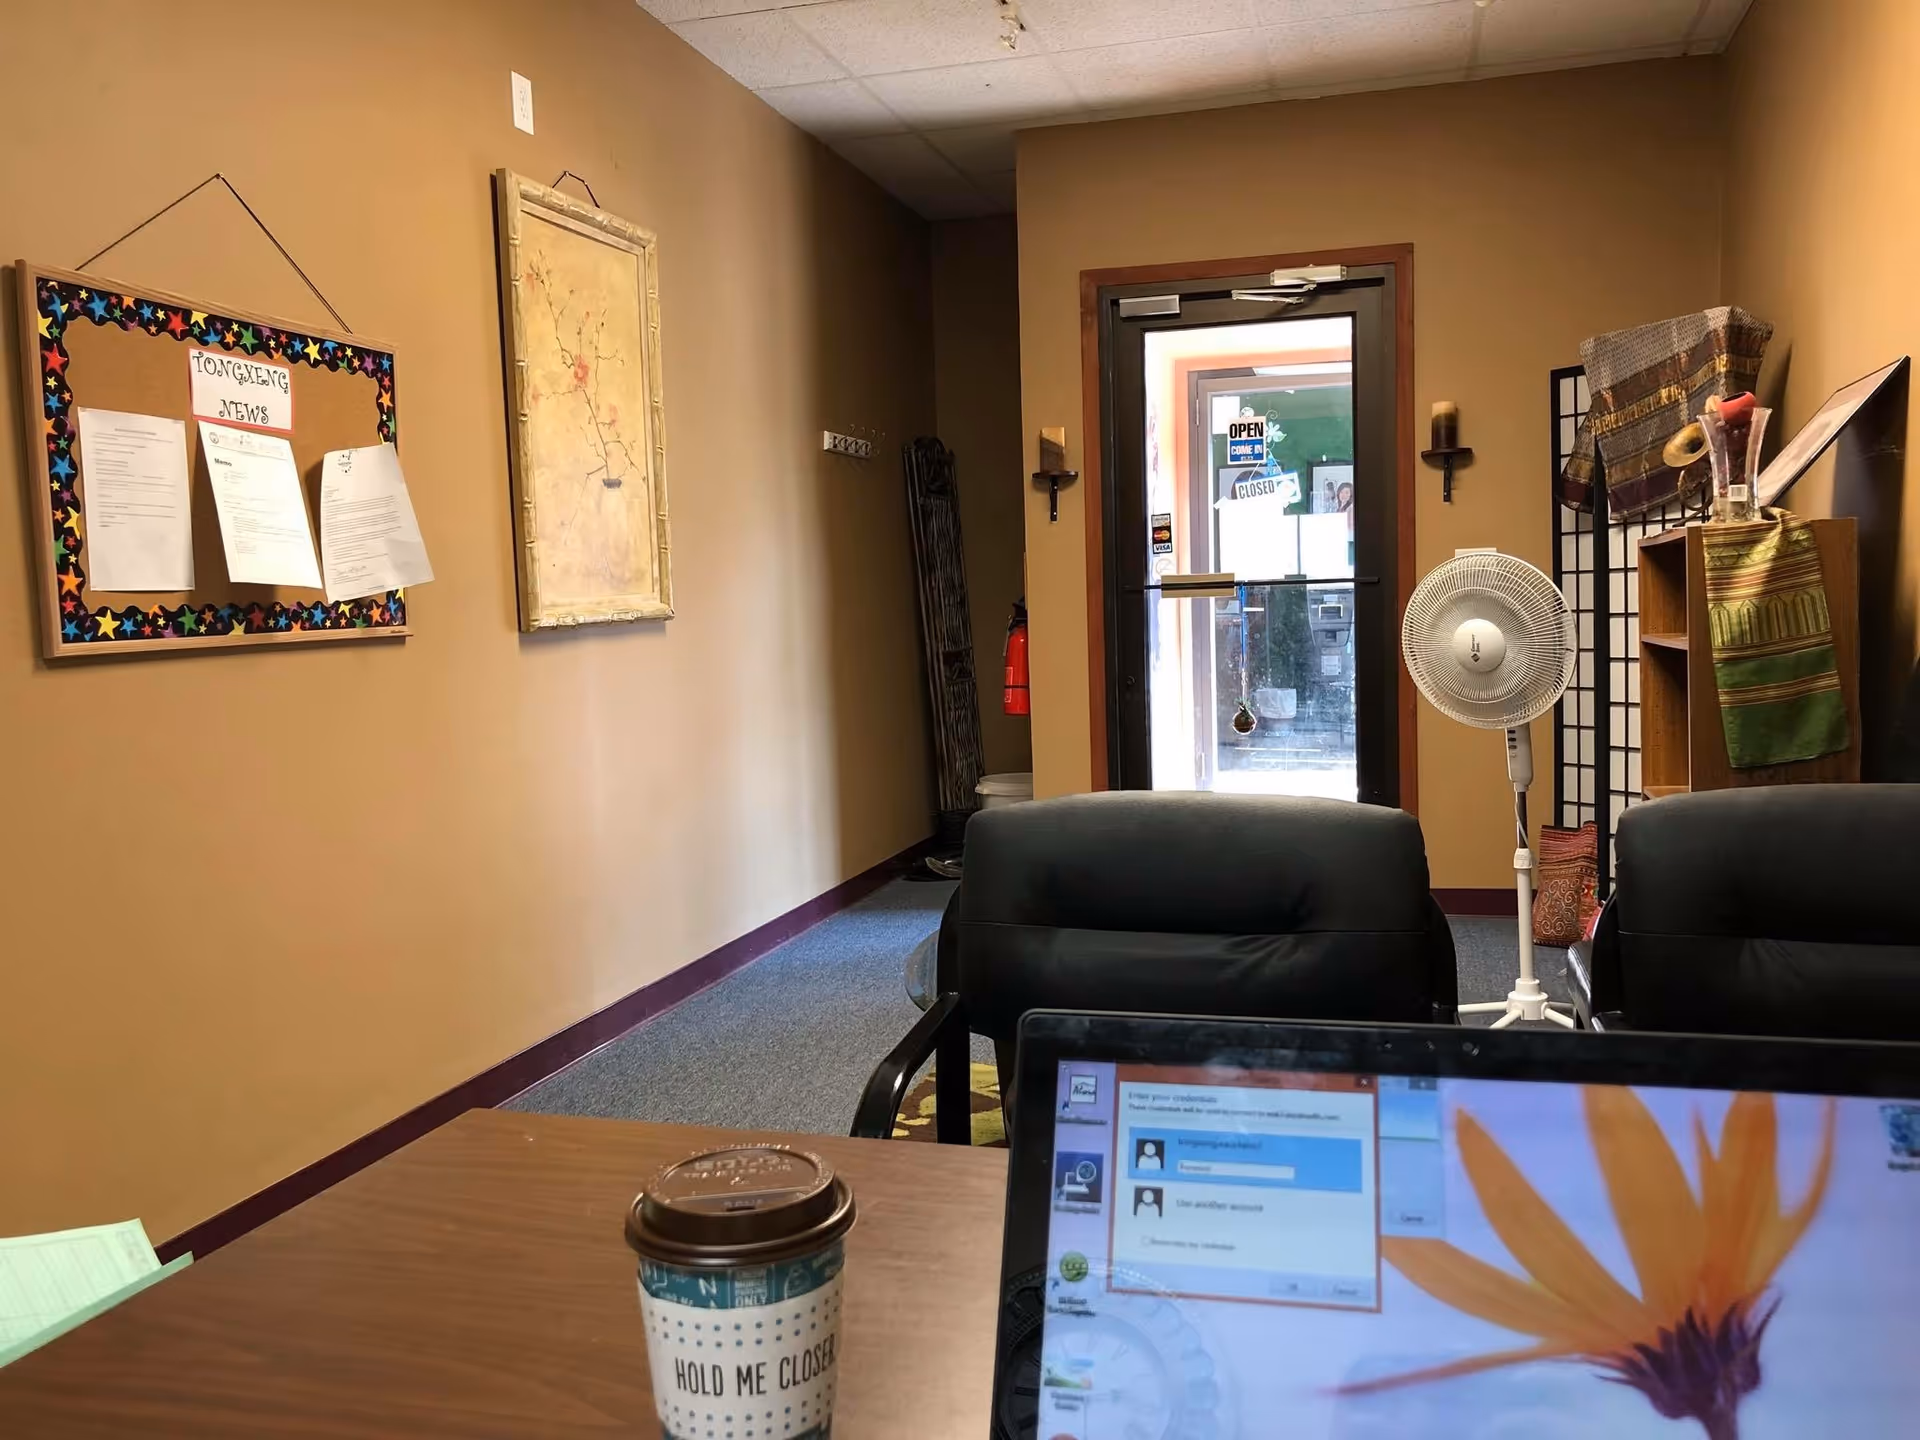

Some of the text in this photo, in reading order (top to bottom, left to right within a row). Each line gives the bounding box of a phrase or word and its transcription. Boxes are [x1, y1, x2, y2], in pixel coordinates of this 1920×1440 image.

[192, 351, 289, 395] TONGXENG
[218, 399, 269, 425] NEWS
[1229, 421, 1264, 439] OPEN
[1231, 444, 1263, 455] COME IN
[1238, 479, 1275, 500] CLOSED
[675, 1357, 724, 1397] HOLD
[736, 1361, 768, 1397] ME
